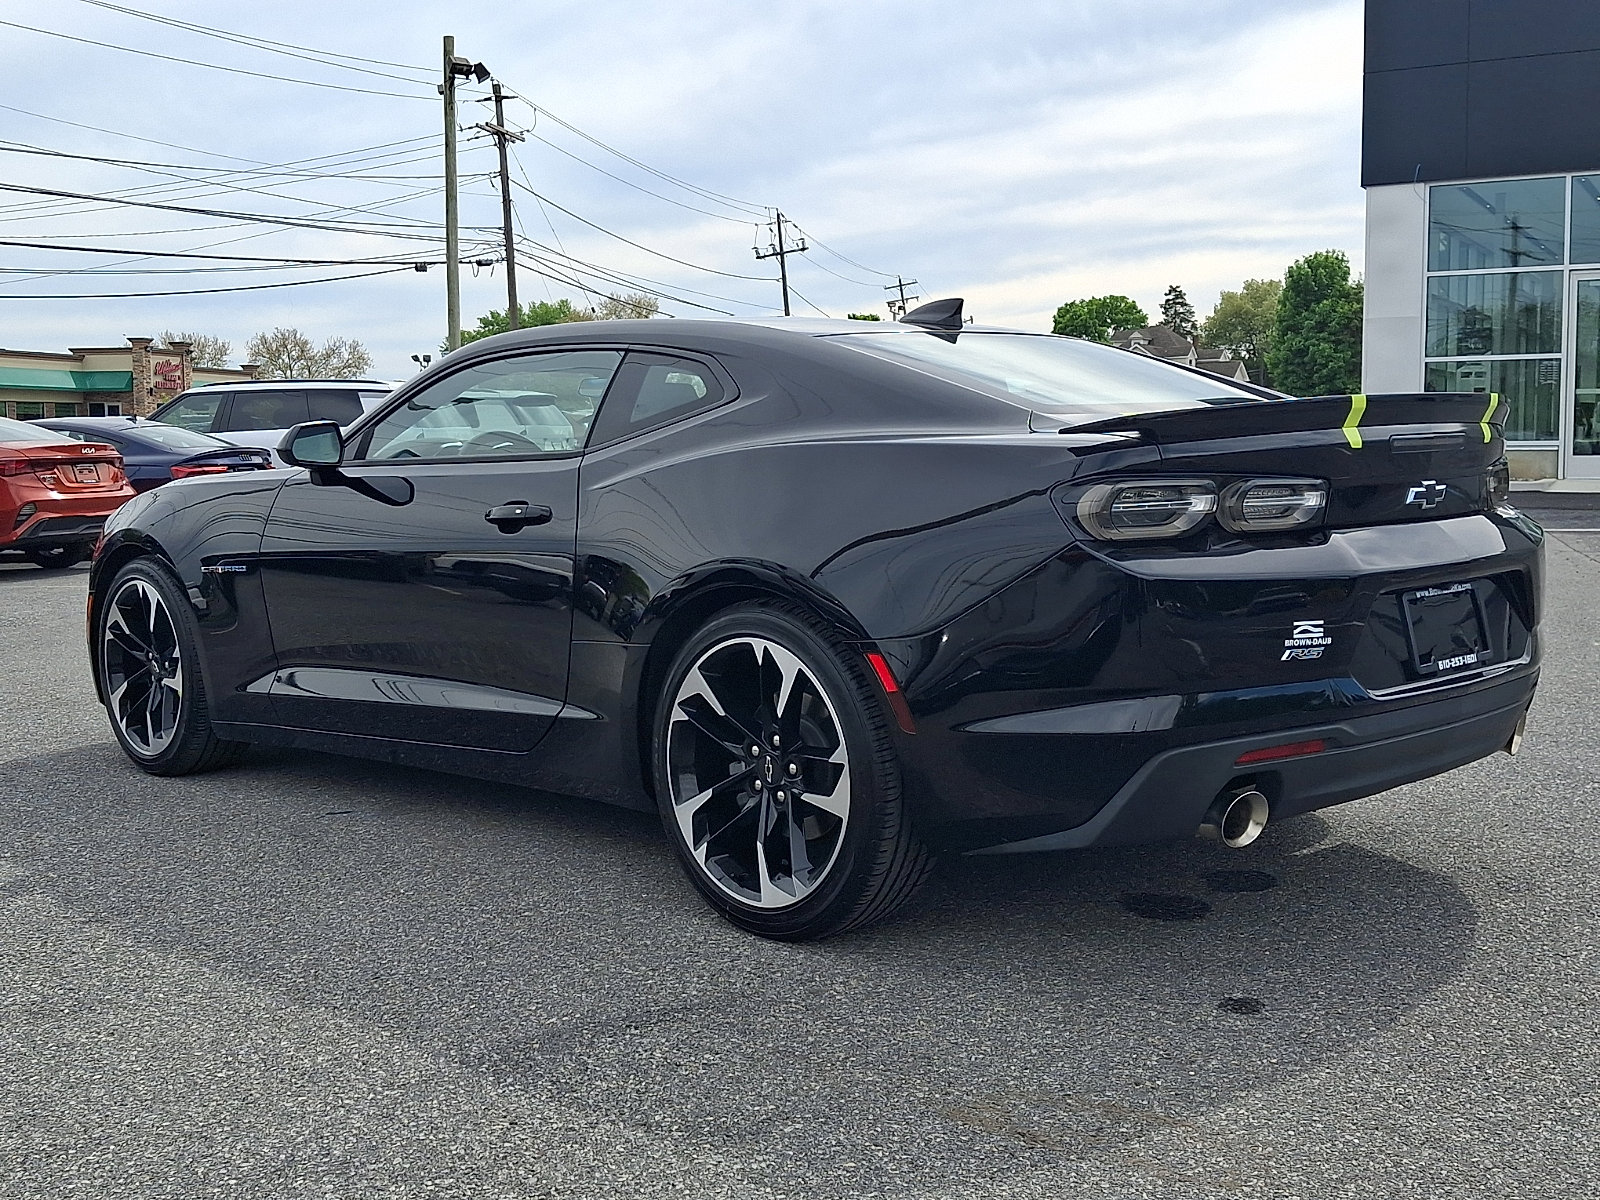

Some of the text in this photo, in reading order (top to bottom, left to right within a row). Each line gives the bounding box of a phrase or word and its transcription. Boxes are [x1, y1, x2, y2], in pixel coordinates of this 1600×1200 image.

[81, 447, 96, 455] KIA
[1284, 637, 1332, 647] BROWN-DAUB
[1281, 647, 1325, 660] RS
